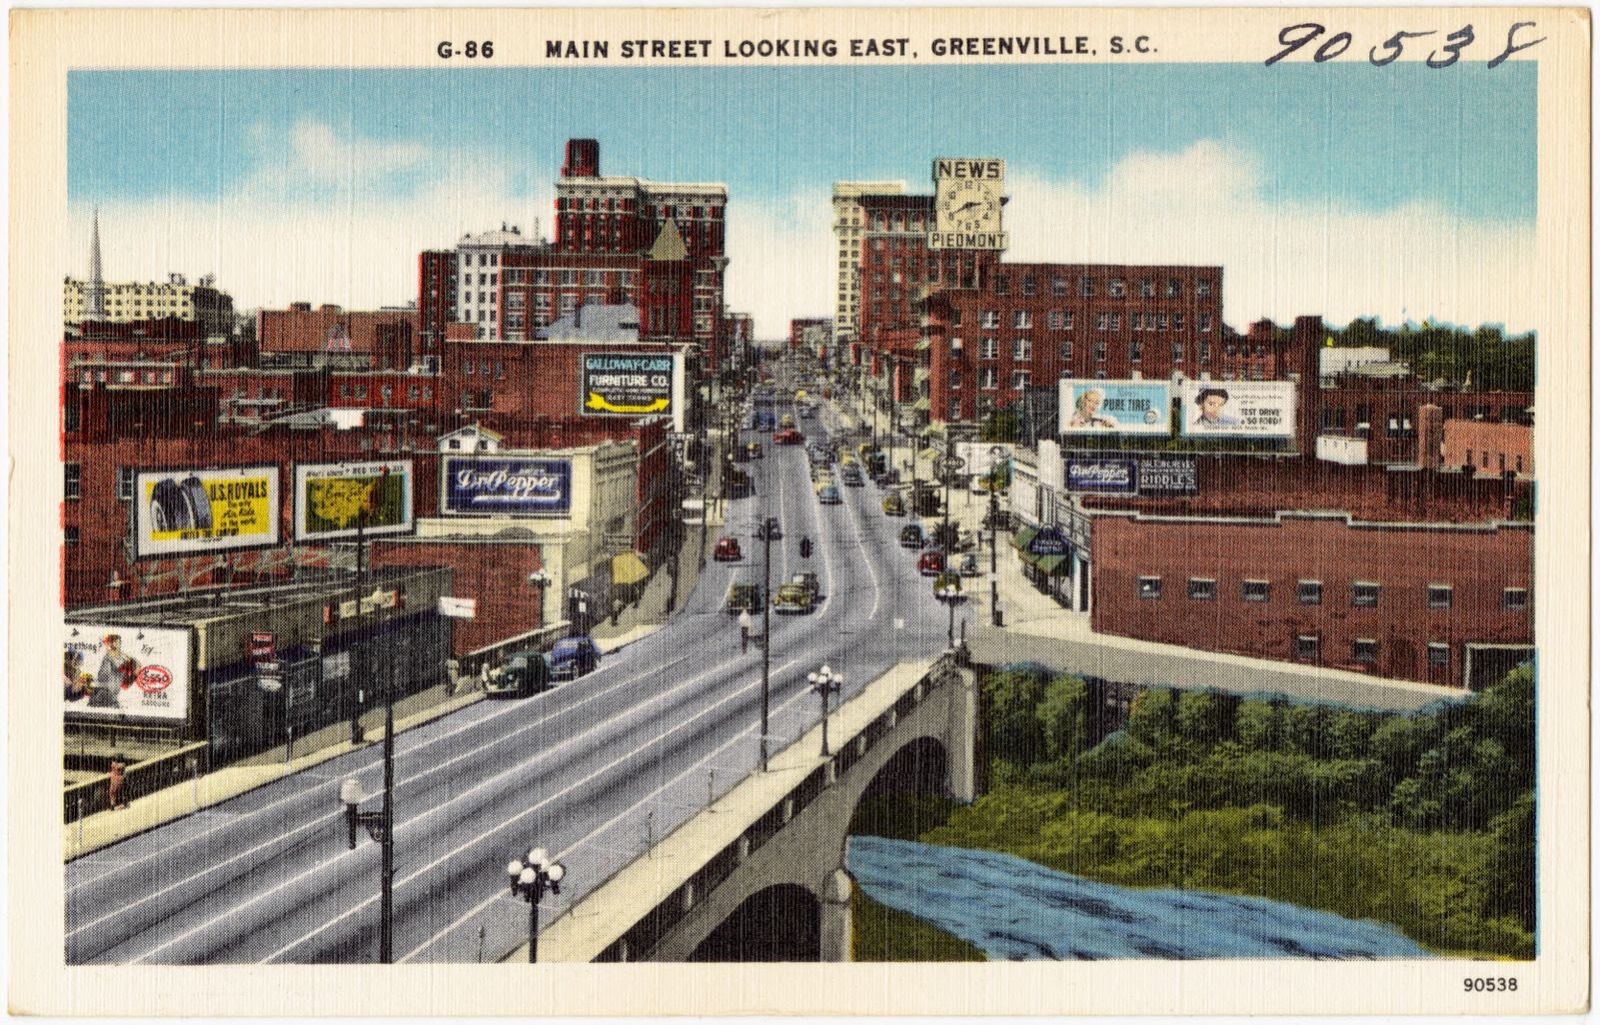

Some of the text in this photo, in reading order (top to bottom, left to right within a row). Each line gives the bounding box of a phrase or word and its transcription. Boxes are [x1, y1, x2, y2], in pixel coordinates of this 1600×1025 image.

[938, 161, 1000, 178] NEWS
[931, 233, 1005, 248] PIEDMONT
[586, 359, 671, 371] GALLOWAY-CARR
[589, 374, 669, 387] FURNITURE CO.
[1103, 398, 1151, 411] PURE TIRES
[486, 464, 560, 497] Pepper
[227, 480, 268, 500] ROYALS
[142, 669, 169, 683] Esso
